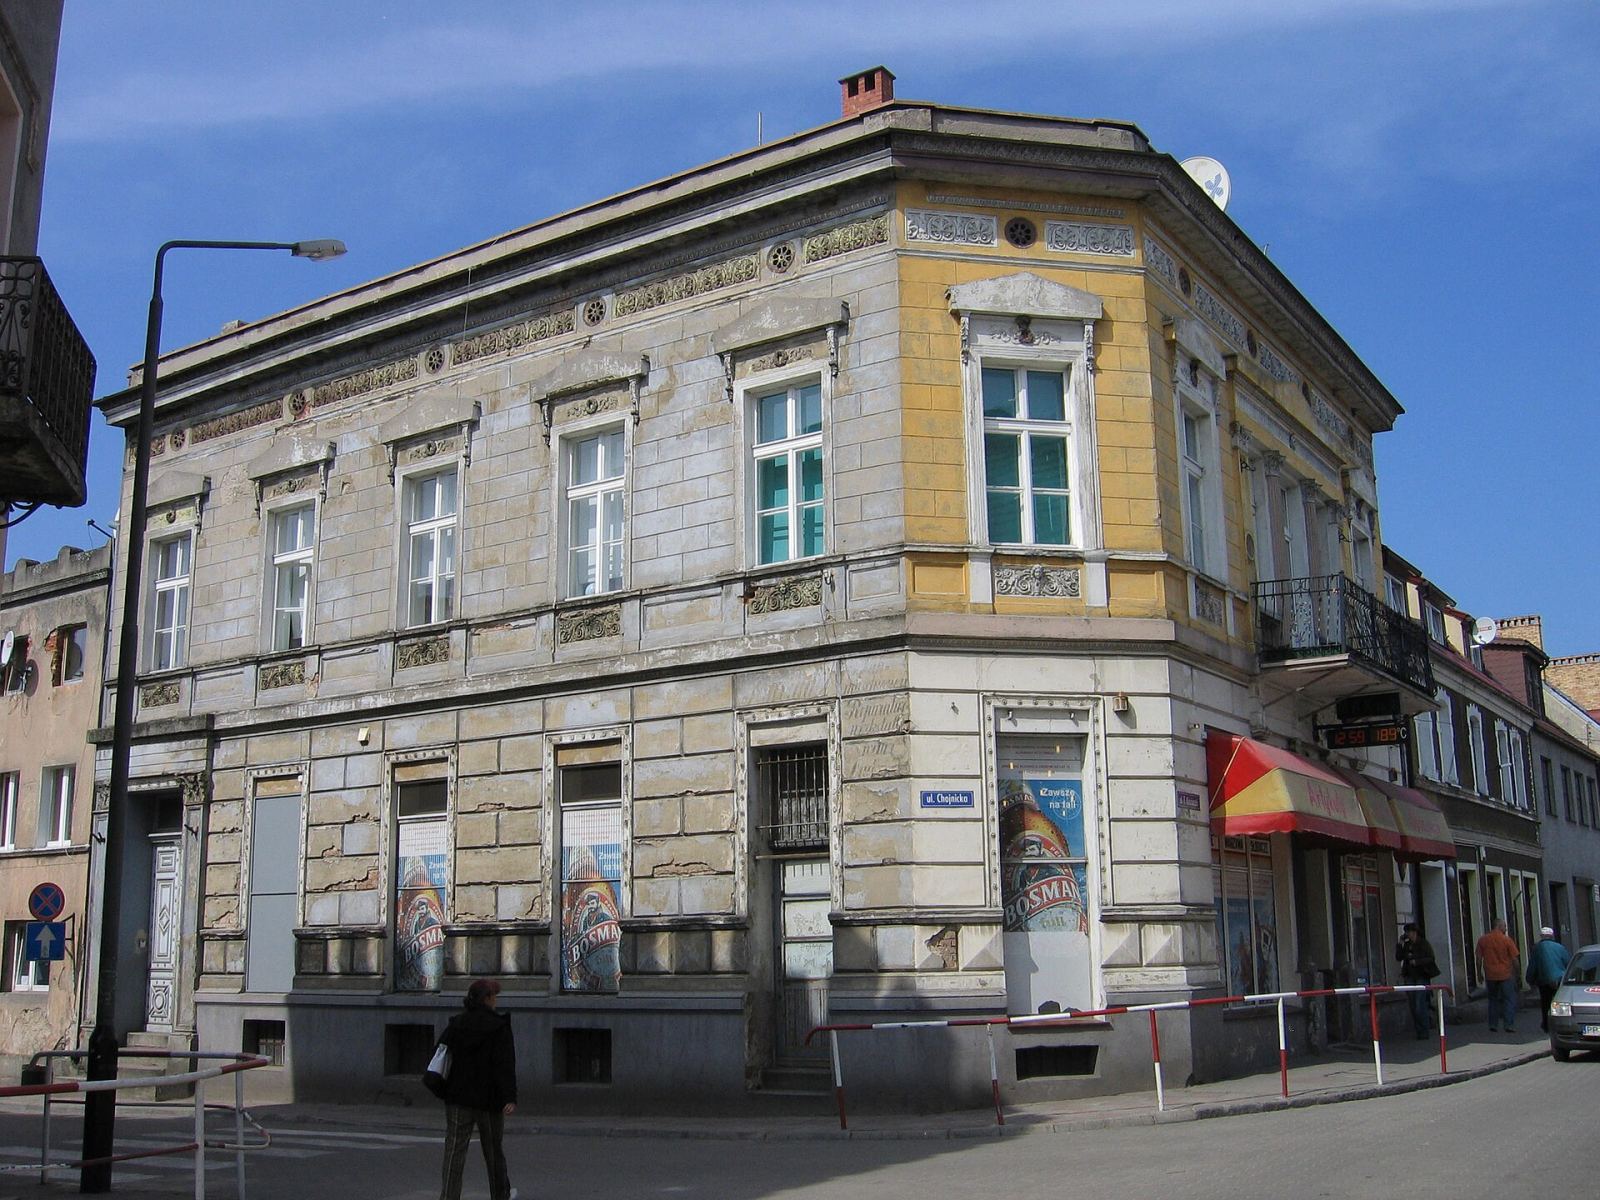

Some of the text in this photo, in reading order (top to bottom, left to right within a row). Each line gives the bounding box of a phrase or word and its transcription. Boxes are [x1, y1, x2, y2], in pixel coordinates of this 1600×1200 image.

[926, 793, 968, 804] ul. Chojnicka
[1005, 881, 1079, 927] BOSMAN
